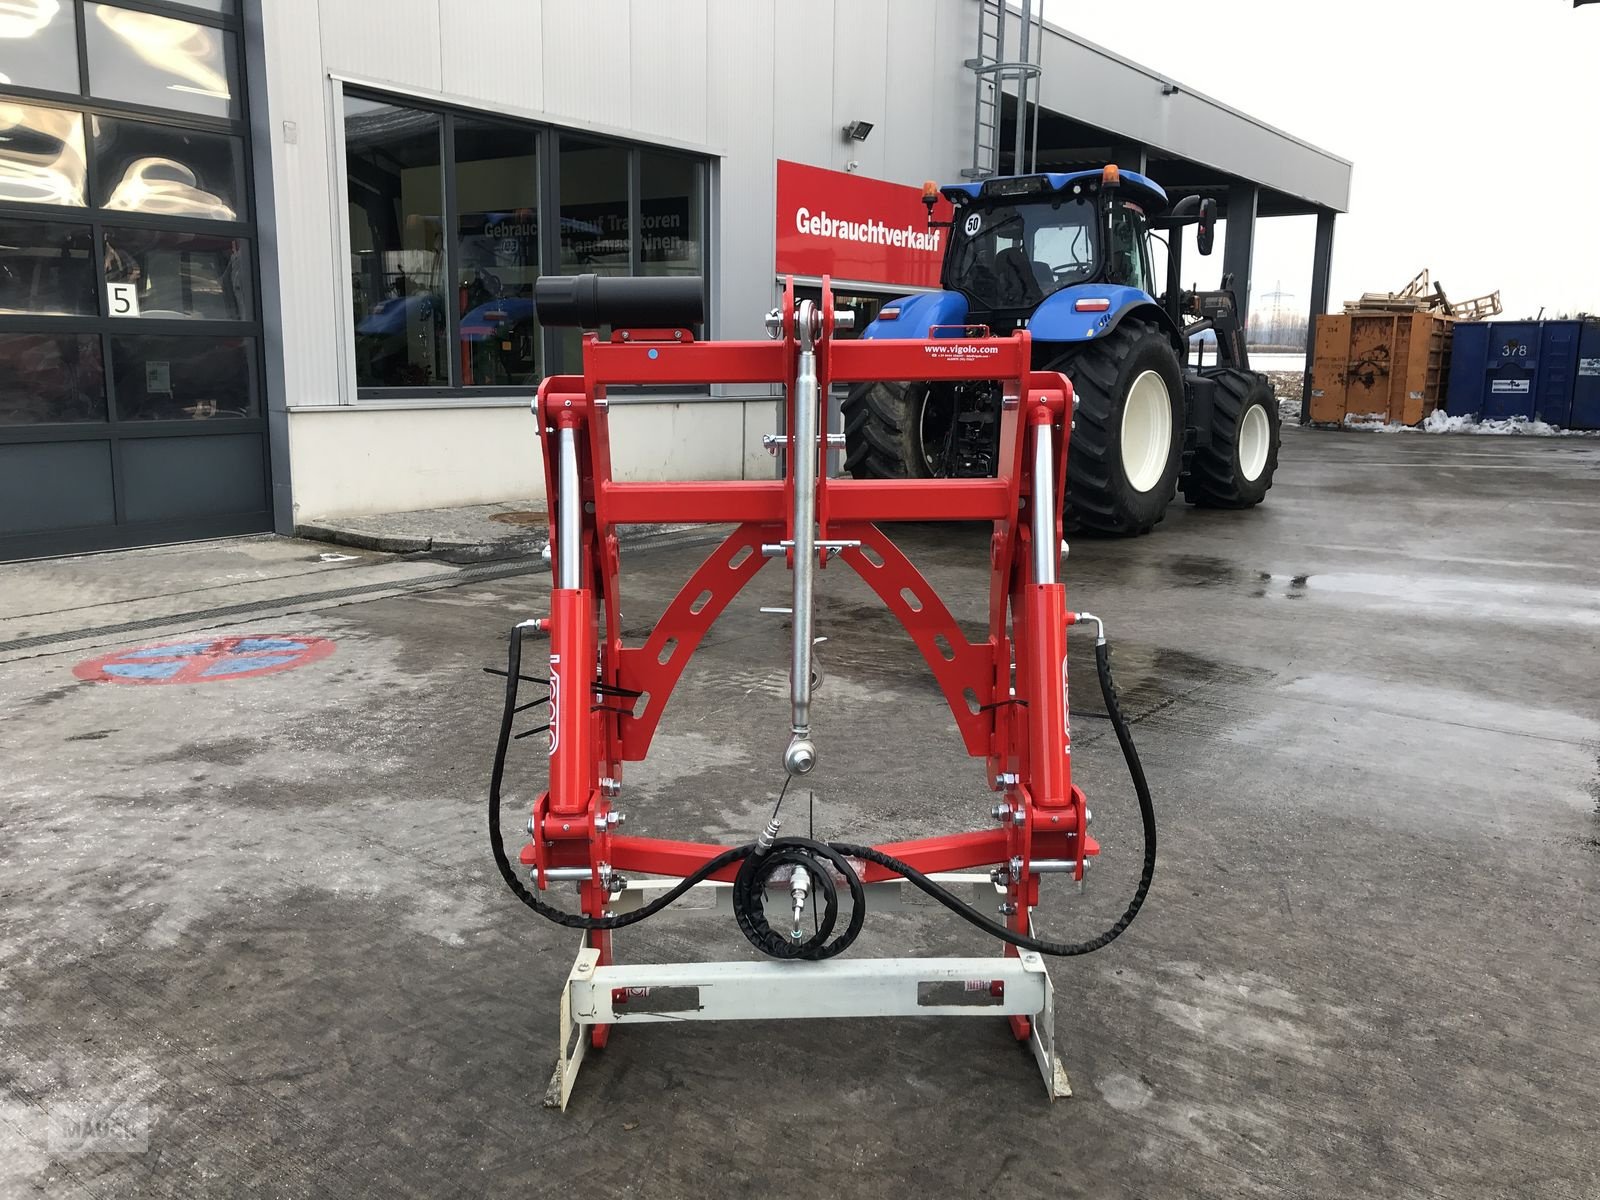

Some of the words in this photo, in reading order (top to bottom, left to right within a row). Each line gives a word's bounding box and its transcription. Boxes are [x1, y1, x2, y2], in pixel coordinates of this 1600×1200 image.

[796, 207, 940, 251] Gebrauchtverkauf
[967, 217, 979, 232] 50
[114, 287, 130, 313] 5
[924, 344, 998, 354] www.vigolo.com
[1502, 344, 1527, 357] 378
